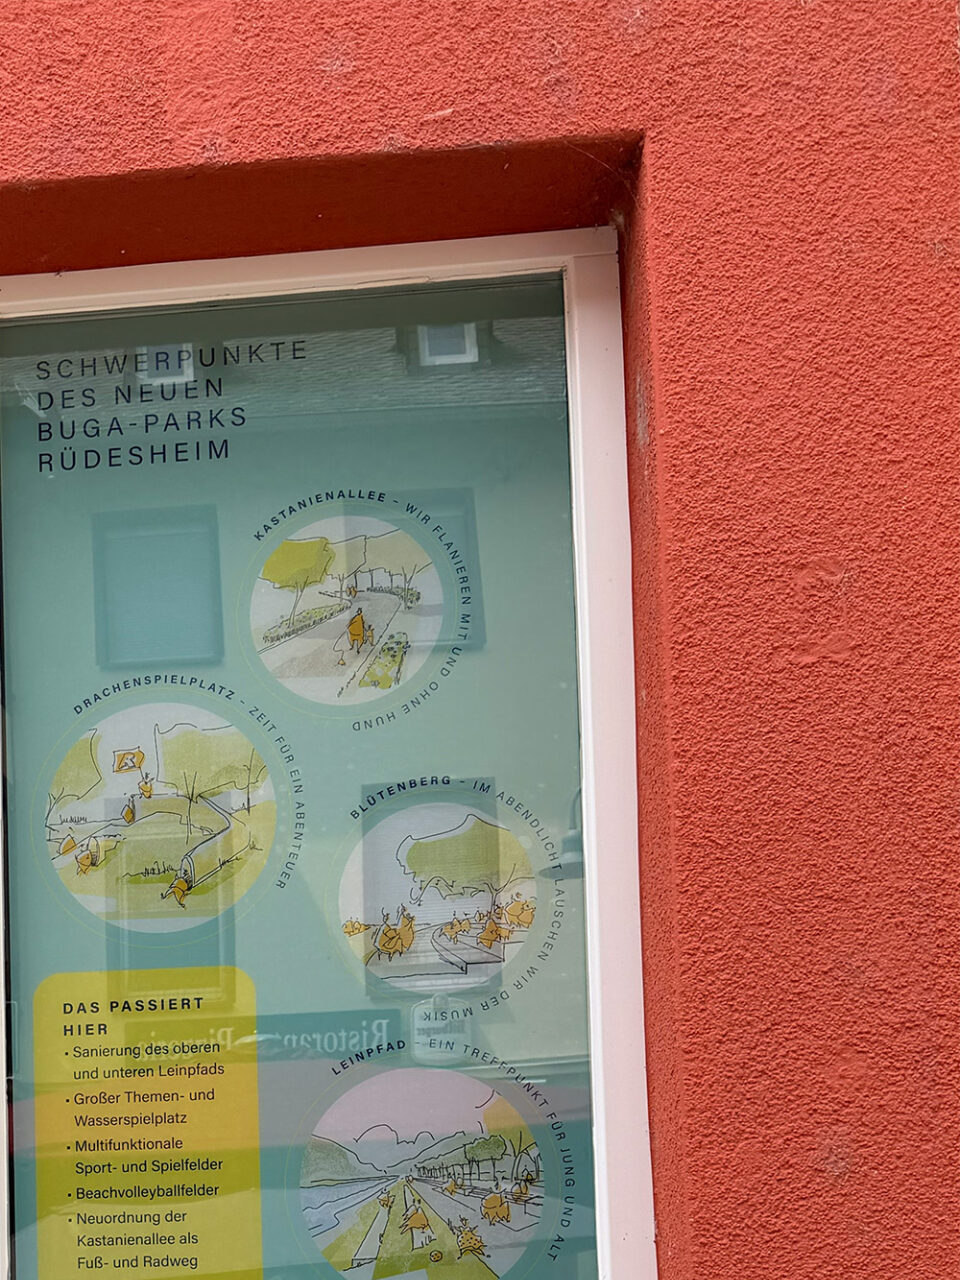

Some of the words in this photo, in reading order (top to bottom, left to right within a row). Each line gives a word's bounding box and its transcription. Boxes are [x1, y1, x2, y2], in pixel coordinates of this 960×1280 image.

[37, 341, 308, 380] SCHWERPUNKTE
[37, 390, 96, 411] DES
[115, 378, 224, 405] NEUEN
[38, 407, 247, 441] BUGA-PARKS
[39, 440, 231, 472] RÜDESHEIM
[254, 489, 386, 540] KASTANIENALLEE
[406, 503, 430, 525] WIR
[433, 525, 472, 605] FLANIEREN
[461, 614, 472, 640] MIT
[441, 647, 462, 677] UND
[74, 675, 235, 714] DRACHENSPIELPLATZ
[402, 681, 438, 714] OHNE
[248, 706, 277, 734] ZEIT
[353, 713, 396, 731] HUND
[275, 736, 294, 761] FÜR
[290, 769, 303, 793] EIN
[473, 780, 491, 793] IM
[350, 776, 451, 819] BLÜTENBERG
[496, 791, 562, 870] ABENDLICHT
[276, 802, 305, 889] ABENTEUER
[539, 879, 565, 960] LAUSCHEN
[513, 967, 538, 990] WIR
[63, 1002, 99, 1015] DAS
[110, 998, 204, 1012] PASSIERT
[481, 990, 509, 1011] DER
[424, 1007, 473, 1021] MUSIK
[63, 1023, 108, 1036] HIER
[73, 1044, 140, 1060] Sanierung
[145, 1042, 170, 1055] des
[173, 1041, 220, 1053] oberen
[429, 1039, 455, 1050] EIN
[332, 1040, 405, 1076] LEINPFAD
[73, 1067, 98, 1080] und
[103, 1066, 154, 1078] unteren
[159, 1062, 224, 1079] Leinpfads
[463, 1045, 548, 1107] TREFFPUNKT
[74, 1091, 120, 1104] Großer
[124, 1090, 184, 1103] Themen-
[189, 1088, 215, 1101] und
[74, 1111, 187, 1128] Wasserspielplatz
[546, 1112, 566, 1141] FÜR
[75, 1137, 183, 1152] Multifunktionale
[75, 1162, 117, 1176] Sport-
[122, 1160, 147, 1173] und
[151, 1158, 223, 1174] Spielfelder
[561, 1148, 575, 1187] JUNG
[76, 1183, 219, 1200] Beachvolleyballfelder
[76, 1212, 160, 1227] Neuordnung
[164, 1210, 187, 1223] der
[561, 1197, 574, 1228] UND
[77, 1233, 175, 1247] Kastanienallee
[179, 1232, 198, 1244] als
[548, 1234, 564, 1261] ALT
[77, 1256, 109, 1270] Fuß-
[113, 1255, 138, 1268] und
[143, 1254, 198, 1270] Radweg
